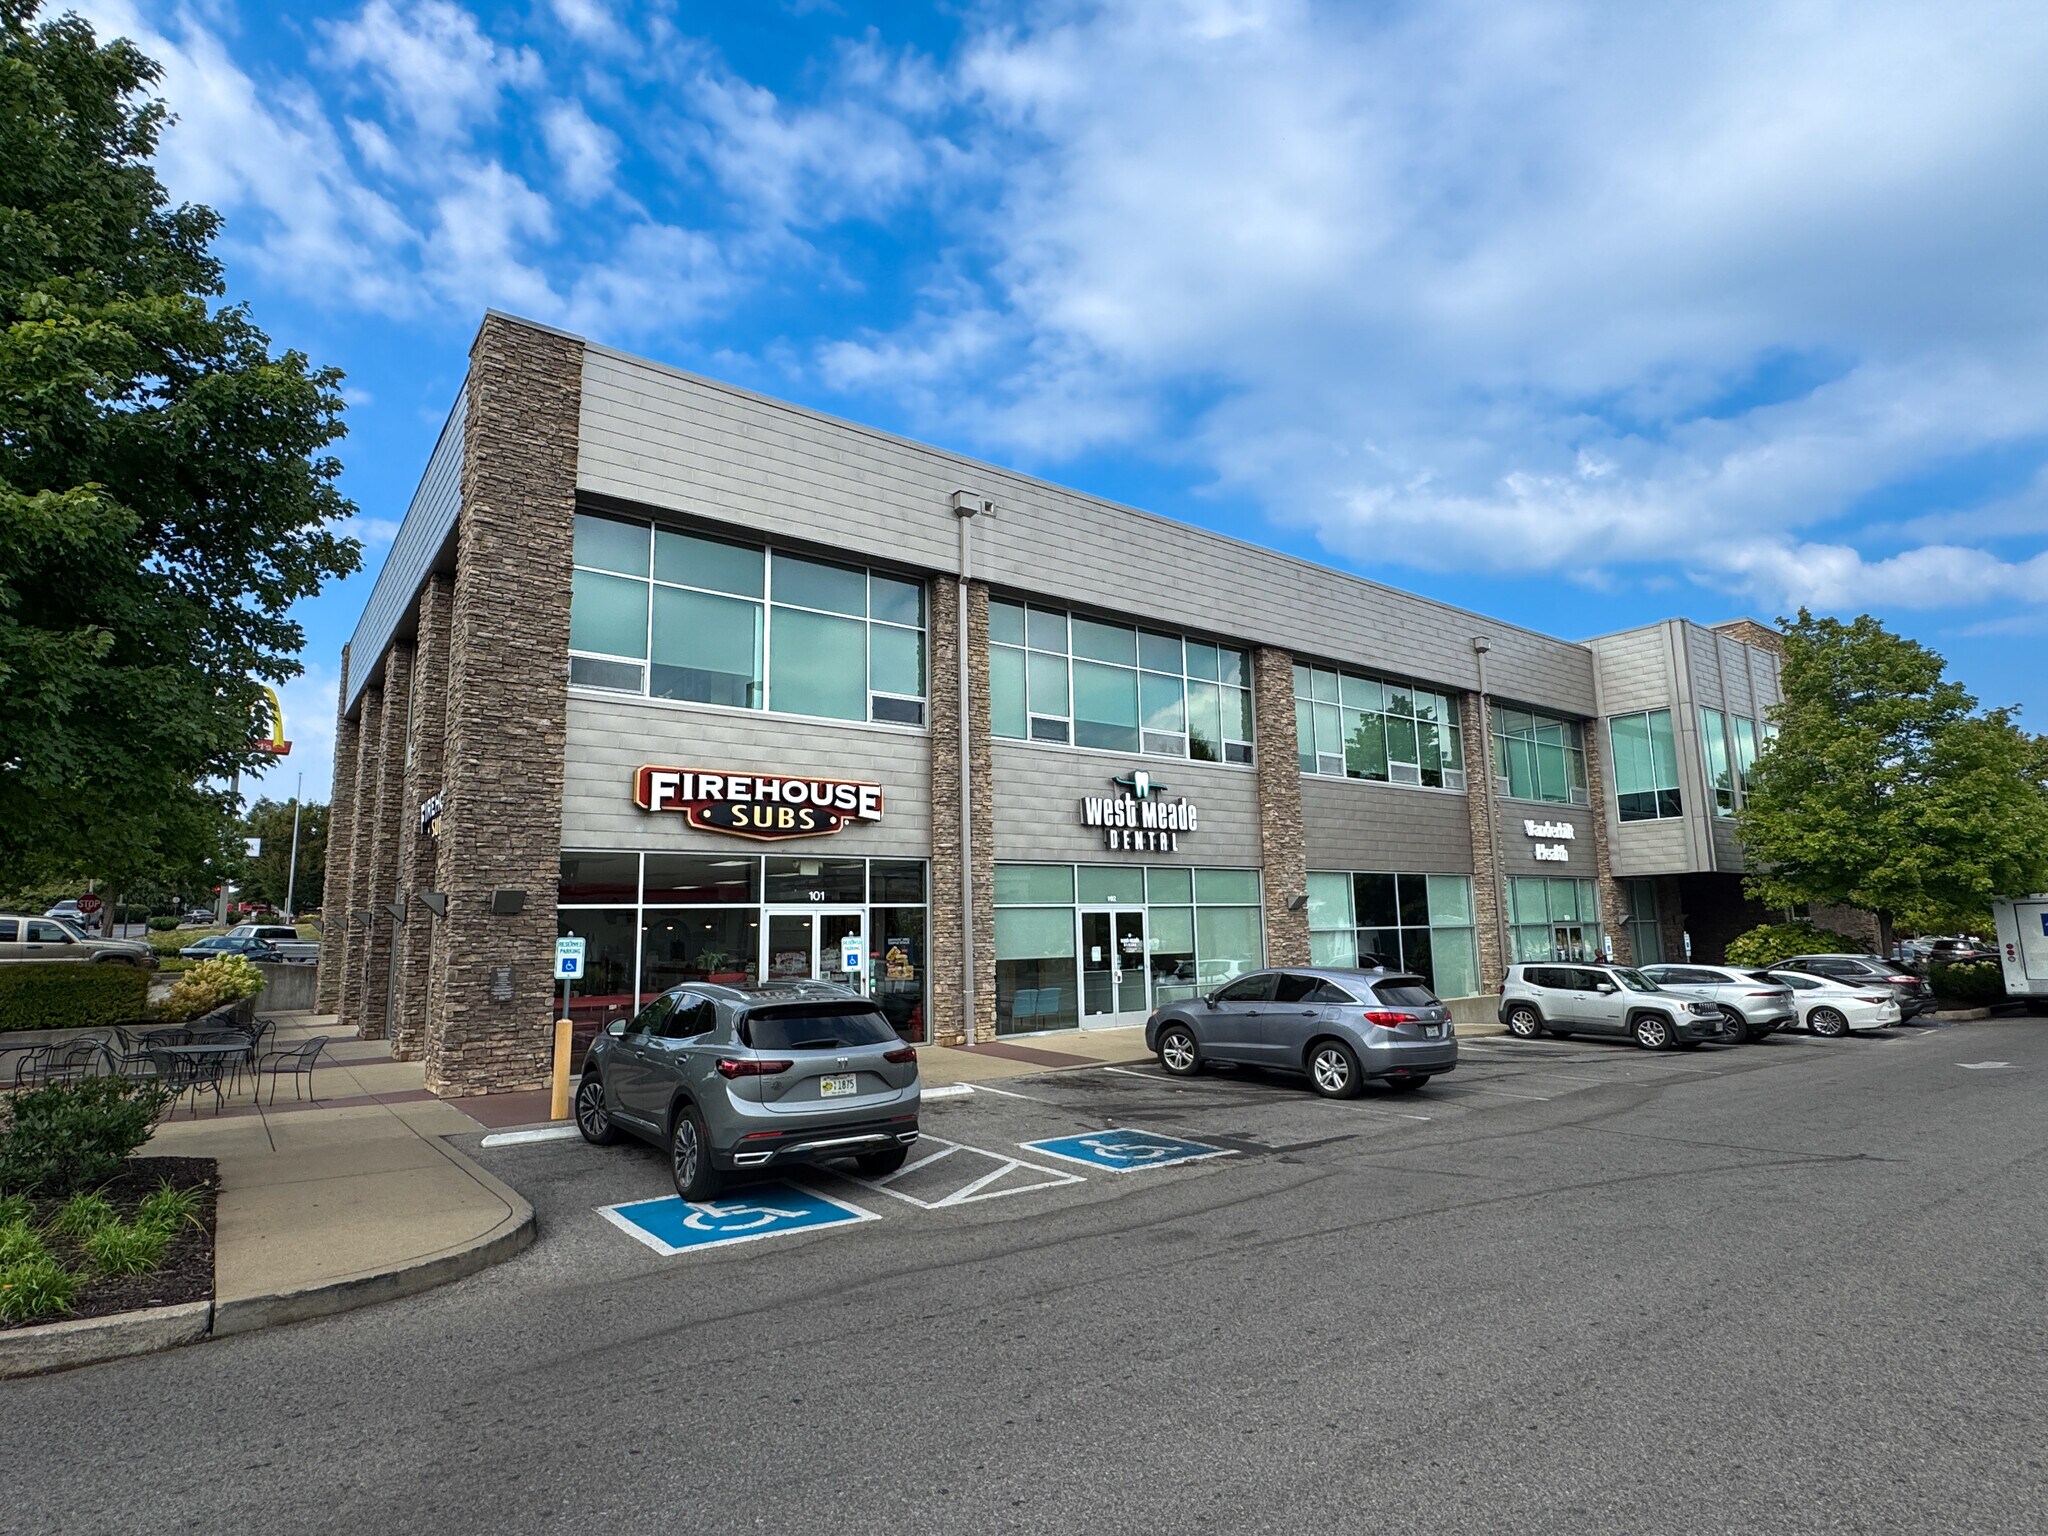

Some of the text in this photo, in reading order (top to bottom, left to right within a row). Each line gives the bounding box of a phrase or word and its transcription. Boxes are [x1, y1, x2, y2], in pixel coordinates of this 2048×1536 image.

[650, 771, 881, 821] FIREHOUSE
[731, 804, 815, 830] SUBS
[1524, 820, 1575, 839] Vanderbilt
[1110, 829, 1178, 851] DENTAL
[1535, 844, 1568, 861] Health
[77, 900, 101, 908] STOP
[808, 890, 825, 901] 101
